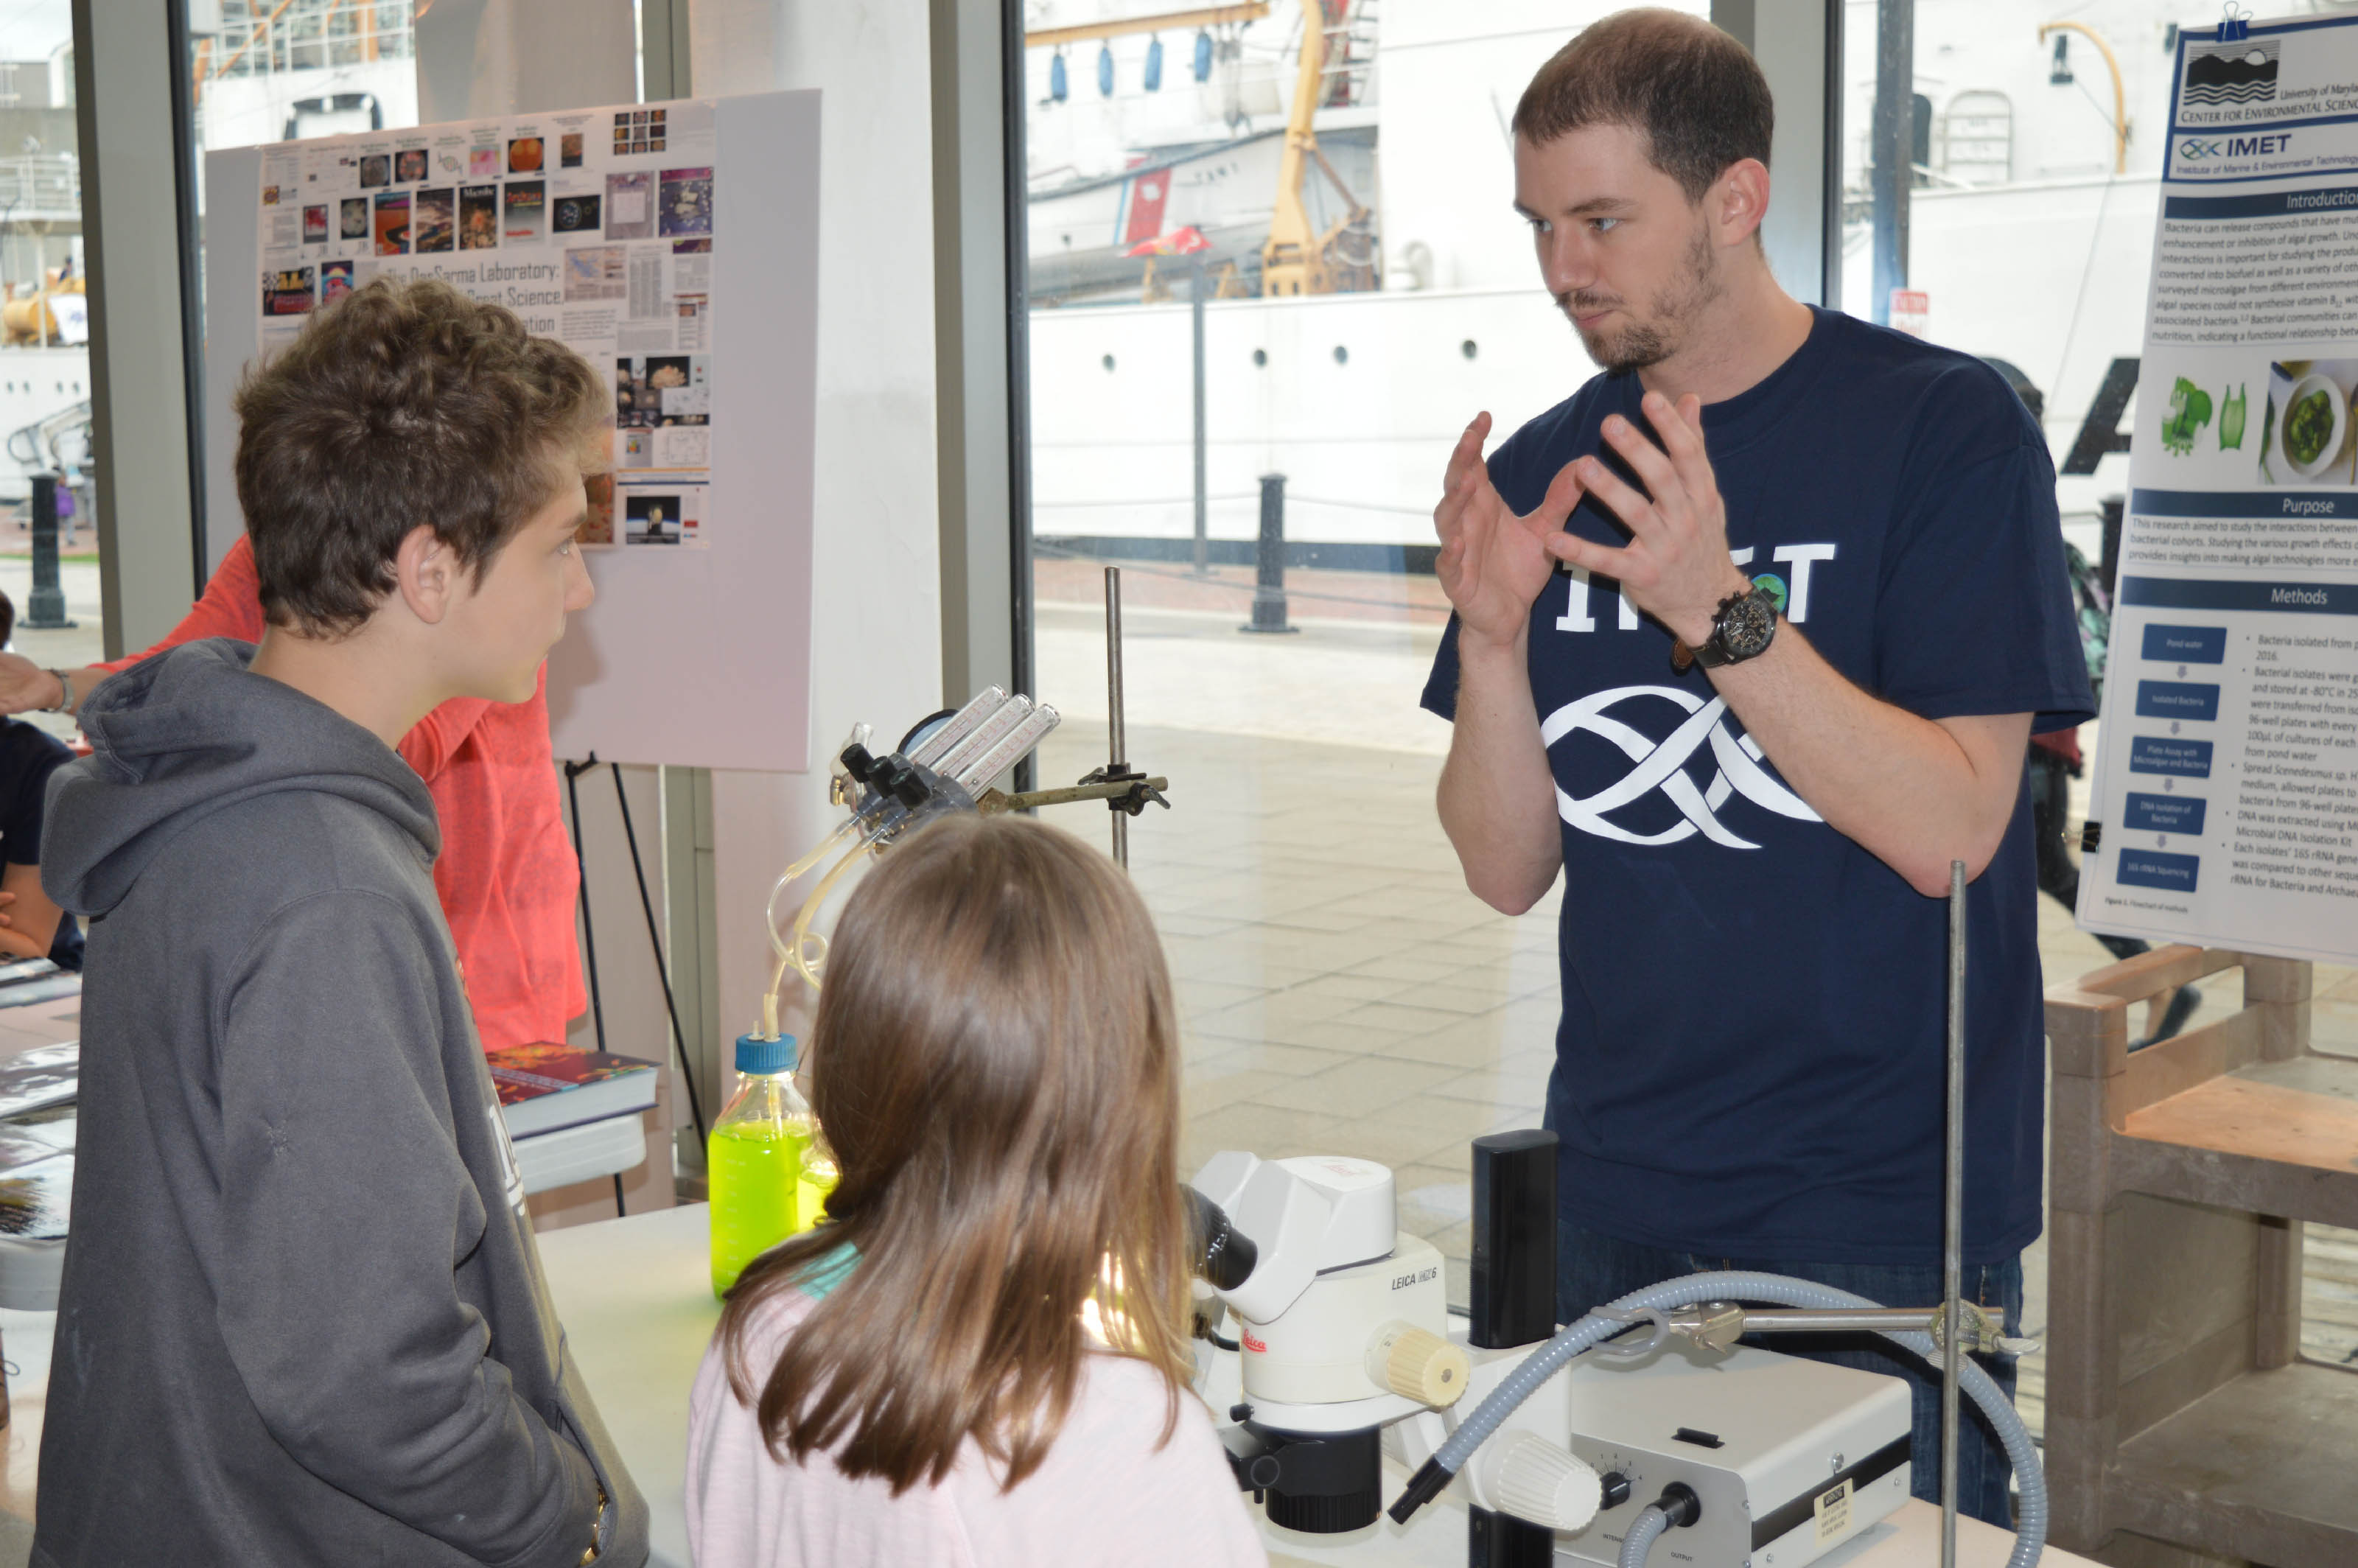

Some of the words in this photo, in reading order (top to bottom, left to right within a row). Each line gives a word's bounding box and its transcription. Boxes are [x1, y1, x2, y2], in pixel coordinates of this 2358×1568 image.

[2280, 87, 2318, 100] University
[2320, 84, 2329, 96] of
[2181, 111, 2221, 123] CENTER
[2224, 110, 2242, 122] FOR
[2245, 102, 2322, 120] ENVIRONMENTAL
[2228, 133, 2292, 157] IMET
[2177, 164, 2211, 175] Institute
[2213, 163, 2222, 174] of
[2224, 162, 2250, 173] Marine
[2253, 161, 2259, 171] &
[2261, 157, 2313, 171] Environmental
[2165, 223, 2202, 234] Bacteria
[2204, 224, 2219, 234] can
[2222, 222, 2251, 233] release
[2253, 219, 2299, 231] compounds
[2301, 217, 2318, 228] that
[2320, 216, 2340, 225] have
[2163, 237, 2225, 248] enhancement
[2237, 235, 2276, 247] inhibition
[2278, 234, 2286, 245] of
[2287, 232, 2307, 246] algal
[2161, 253, 2214, 264] interactions
[2225, 253, 2266, 264] important
[2267, 251, 2279, 262] for
[2281, 248, 2315, 261] studying
[2317, 247, 2331, 258] the
[480, 262, 560, 283] Laboratory:
[2159, 268, 2205, 279] converted
[2207, 268, 2224, 279] into
[2225, 267, 2255, 279] biofuel
[2267, 265, 2284, 277] well
[2303, 264, 2330, 276] variety
[2332, 262, 2343, 273] of
[507, 286, 565, 307] Science,
[2158, 284, 2199, 296] surveyed
[2200, 284, 2247, 296] microalgae
[2248, 283, 2268, 293] from
[2270, 281, 2304, 293] different
[2156, 298, 2177, 311] algal
[2179, 299, 2211, 310] species
[2214, 298, 2237, 310] could
[2239, 299, 2253, 309] not
[2297, 295, 2328, 307] vitamin
[2154, 315, 2202, 326] associated
[2250, 312, 2285, 325] Bacterial
[2287, 310, 2341, 323] communities
[2342, 310, 2357, 321] can
[2197, 330, 2239, 343] indicating
[2247, 329, 2287, 340] functional
[2289, 326, 2338, 340] relationship
[2282, 497, 2335, 516] Purpose
[2133, 517, 2150, 529] This
[2152, 519, 2191, 531] research
[2192, 519, 2218, 531] aimed
[2219, 521, 2229, 531] to
[2231, 520, 2251, 534] study
[2253, 520, 2267, 532] the
[2269, 522, 2317, 533] interactions
[2319, 522, 2358, 534] between
[2130, 533, 2170, 545] bacterial
[2208, 535, 2242, 550] Studying
[2245, 536, 2259, 548] the
[2260, 538, 2288, 549] various
[2290, 538, 2320, 551] growth
[2323, 538, 2351, 550] effects
[2129, 549, 2166, 561] provides
[2169, 550, 2201, 564] insights
[2203, 551, 2220, 562] into
[2222, 551, 2250, 565] making
[2252, 553, 2271, 566] algal
[2273, 553, 2325, 567] technologies
[2327, 556, 2351, 567] more
[1556, 543, 1836, 632] IT
[2271, 587, 2328, 605] Methods
[2258, 634, 2292, 646] Bacteria
[2294, 636, 2329, 648] isolated
[2331, 637, 2352, 649] from
[2256, 650, 2280, 661] 2016.
[2254, 665, 2290, 678] Bacterial
[2292, 668, 2326, 680] isolates
[2329, 672, 2351, 682] were
[2252, 682, 2268, 693] and
[2270, 684, 2298, 695] stored
[2337, 687, 2345, 697] in
[2250, 700, 2271, 709] were
[2273, 700, 2323, 713] transferred
[2324, 702, 2345, 714] from
[2248, 713, 2280, 725] 96-well
[2281, 716, 2307, 728] plates
[2309, 718, 2329, 729] with
[2332, 723, 2357, 734] every
[2274, 732, 2284, 742] of
[2285, 732, 2320, 745] cultures
[2323, 735, 2333, 746] of
[2334, 737, 2357, 749] each
[2245, 745, 2265, 757] from
[2267, 748, 2289, 760] pond
[2292, 751, 2317, 761] water
[2243, 761, 2273, 774] Spread
[2274, 763, 2333, 779] Scenedesmus
[2241, 779, 2278, 792] medium,
[2281, 780, 2316, 794] allowed
[2317, 784, 2344, 797] plates
[2347, 788, 2357, 798] to
[2239, 794, 2273, 807] bacteria
[2275, 796, 2297, 808] from
[2299, 799, 2332, 811] 96-well
[2237, 810, 2256, 822] DNA
[2259, 813, 2275, 823] was
[2277, 814, 2320, 827] extracted
[2321, 820, 2345, 832] using
[2236, 826, 2276, 839] Microbial
[2278, 830, 2298, 842] DNA
[2340, 836, 2352, 847] Kit
[2233, 841, 2253, 853] Each
[2312, 850, 2334, 861] rRNA
[2232, 860, 2248, 869] was
[2250, 861, 2295, 874] compared
[2297, 865, 2306, 875] to
[2308, 867, 2332, 878] other
[2230, 873, 2253, 885] rRNA
[2255, 875, 2267, 886] for
[2269, 878, 2305, 892] Bacteria
[2307, 883, 2323, 895] and
[1392, 1273, 1416, 1290] LEICA
[1242, 1328, 1267, 1352] Leica
[1670, 1551, 1693, 1562] OUTPUT
